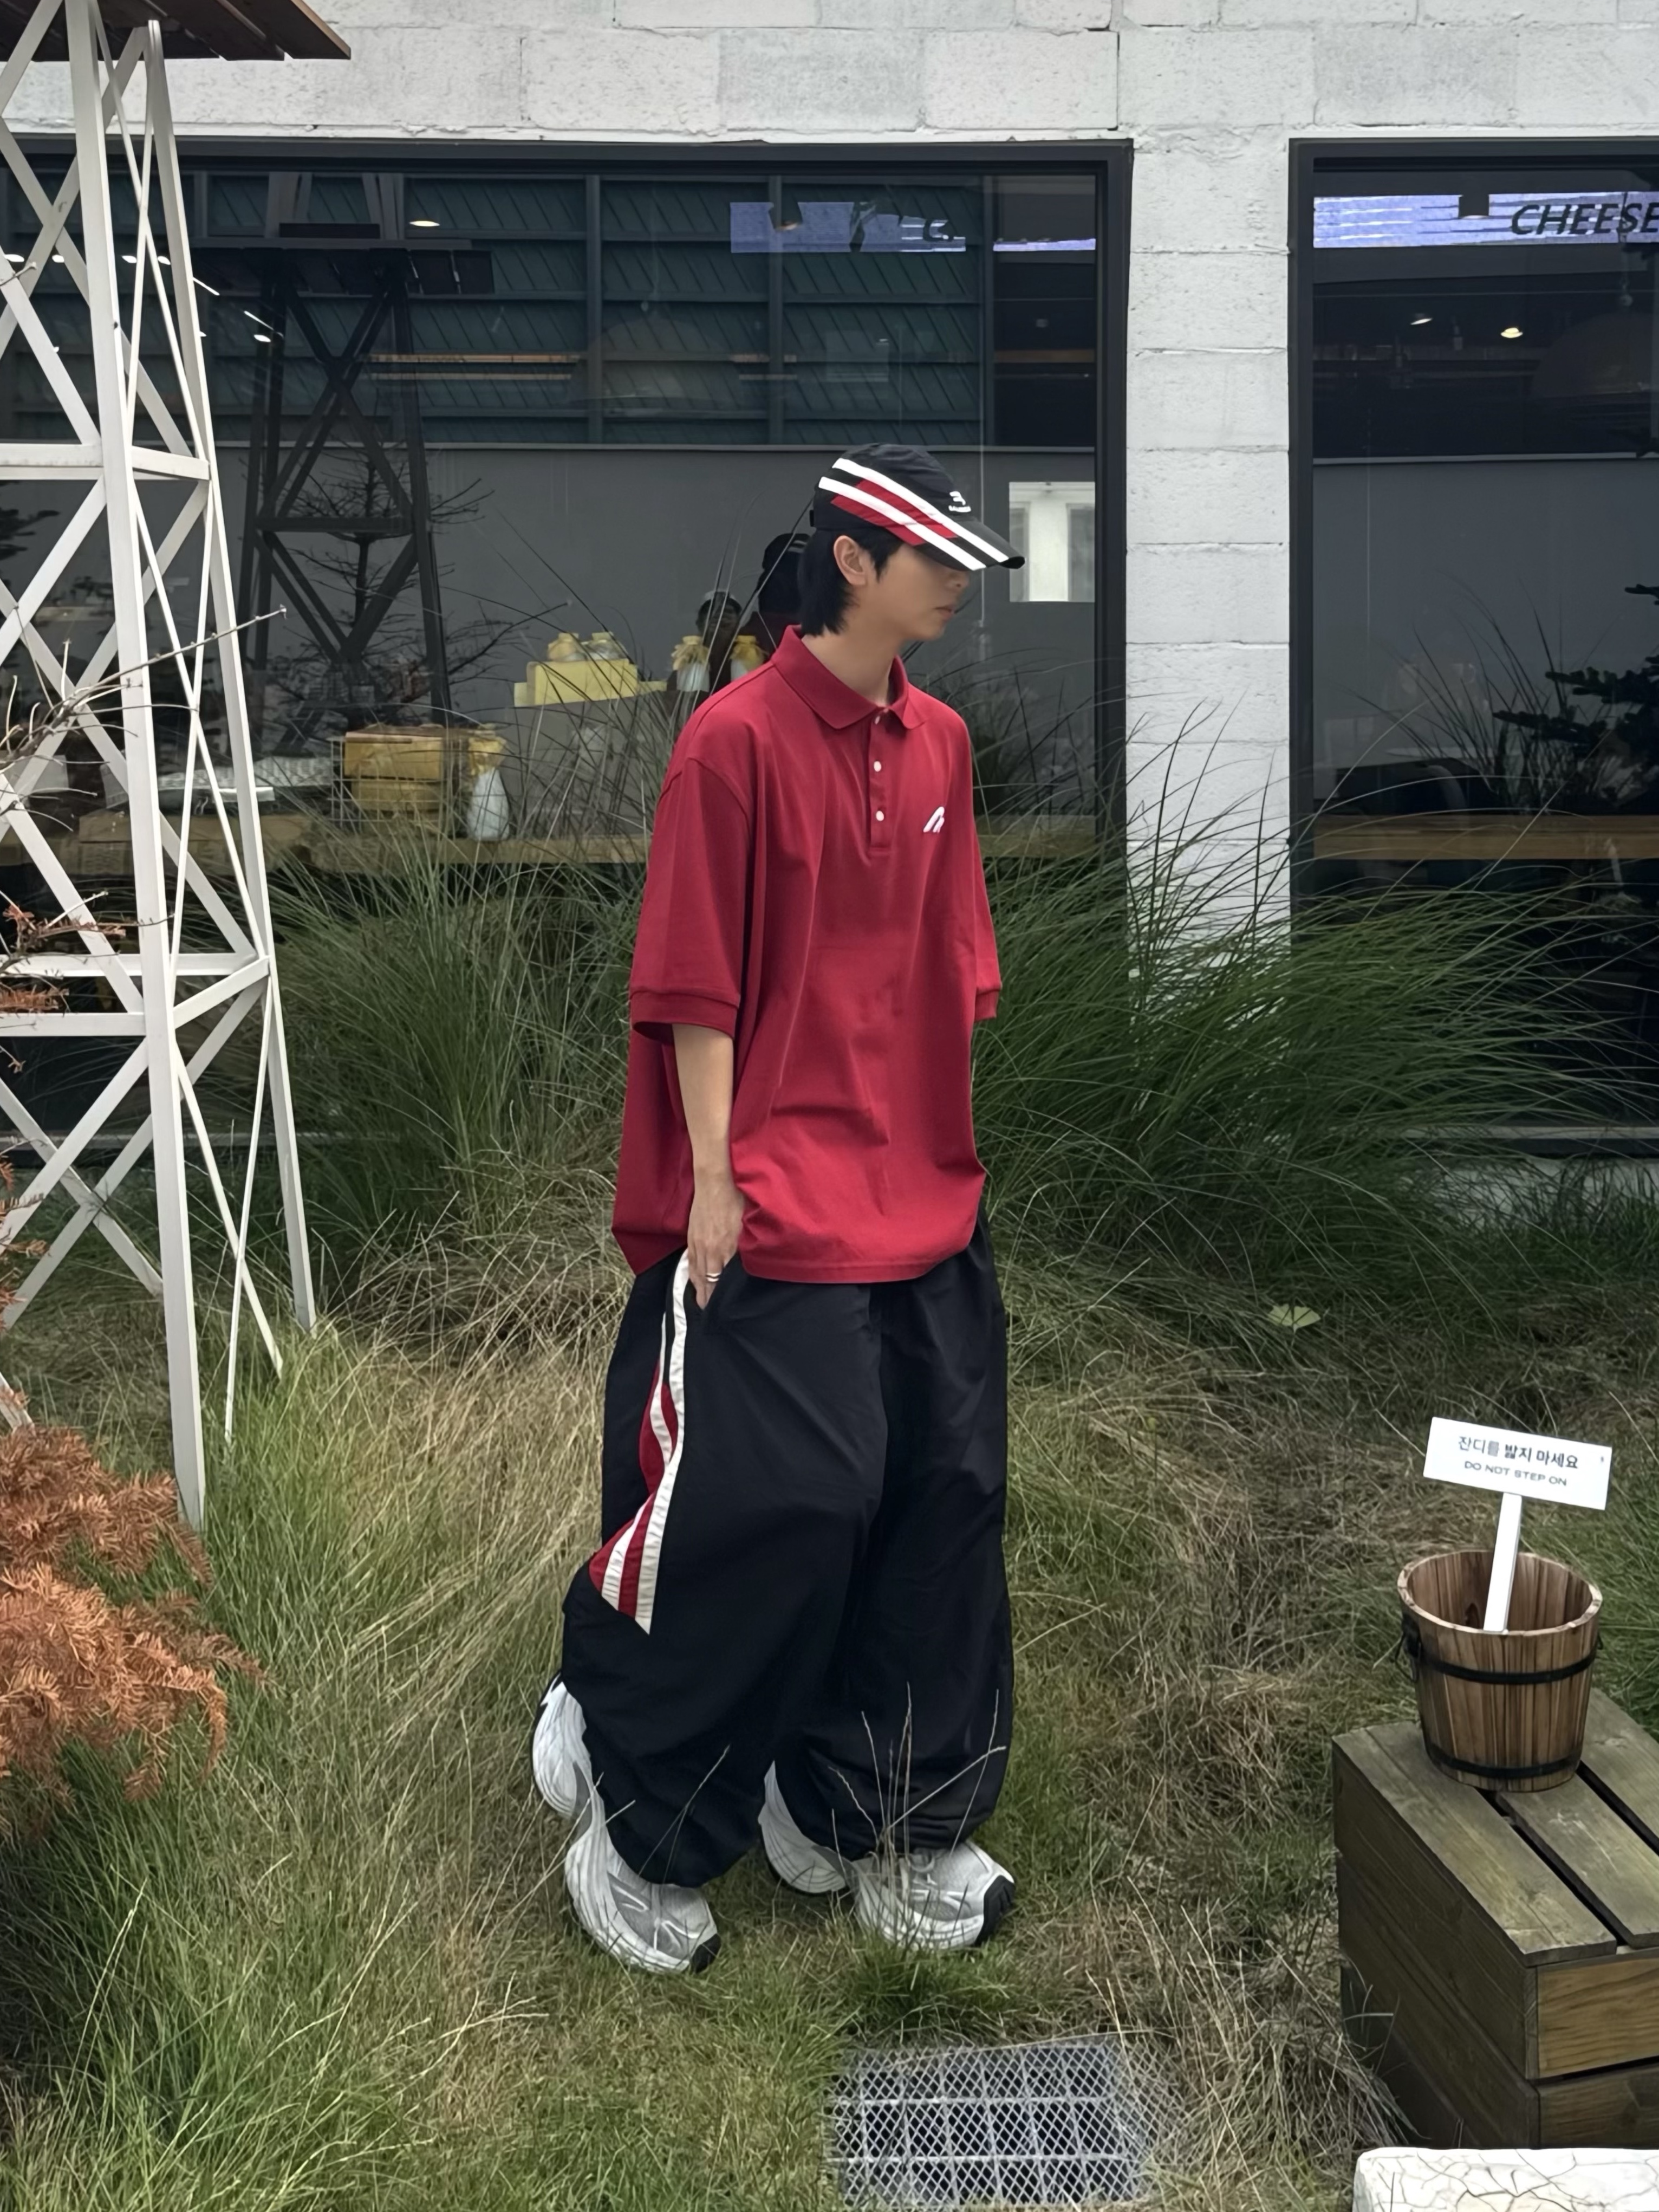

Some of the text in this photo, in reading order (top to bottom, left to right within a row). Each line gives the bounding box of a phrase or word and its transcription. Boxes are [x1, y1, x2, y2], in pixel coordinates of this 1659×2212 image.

[1512, 202, 1659, 235] CHEESE
[1536, 1450, 1578, 1469] 마세요
[1465, 1461, 1566, 1486] DO NOT STEP ON
